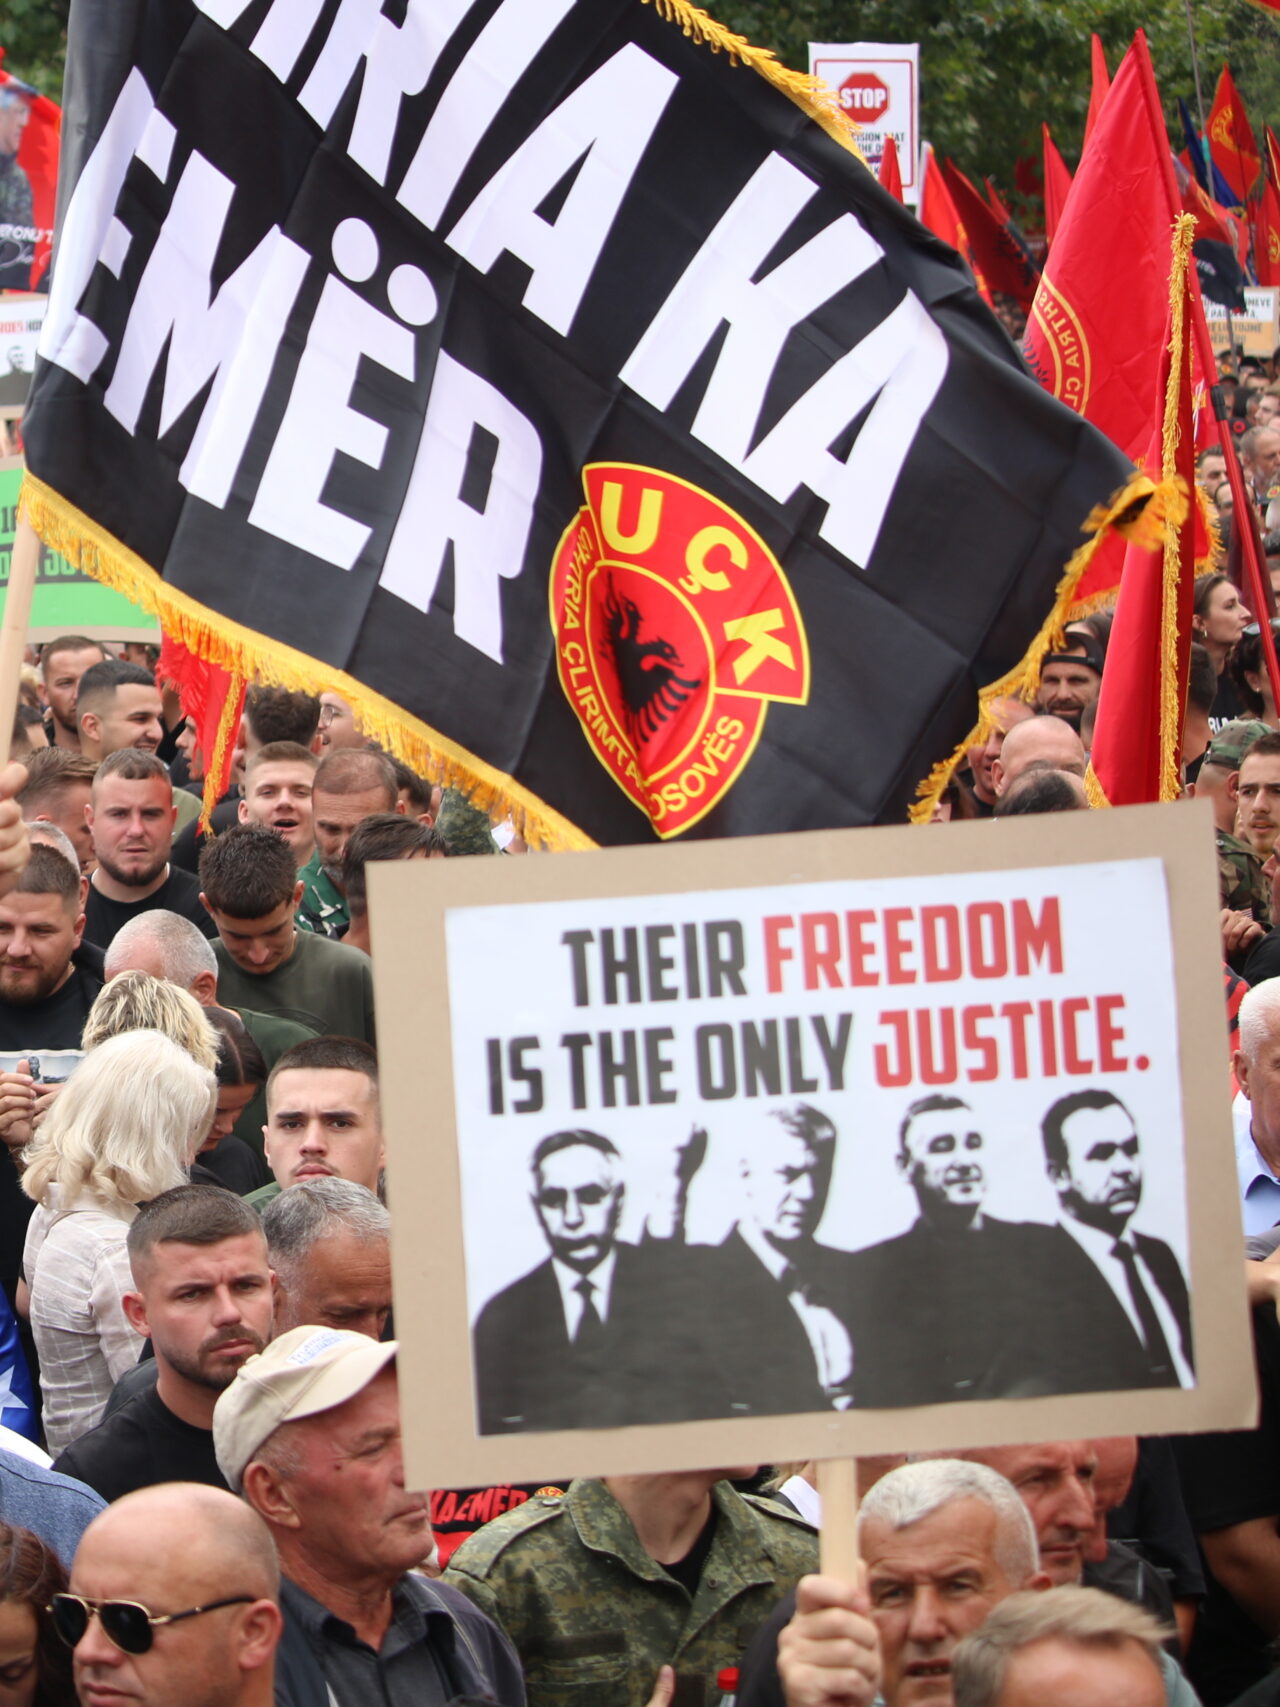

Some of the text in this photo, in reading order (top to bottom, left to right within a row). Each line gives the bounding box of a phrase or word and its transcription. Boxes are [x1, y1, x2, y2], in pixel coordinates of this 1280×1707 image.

[840, 88, 886, 109] STOP
[37, 66, 542, 665] EMËR
[618, 150, 949, 569] KA
[600, 481, 796, 686] UÇK
[561, 896, 1064, 1007] THEIR FREEDOM
[486, 994, 1151, 1115] IS THE ONLY JUSTICE.
